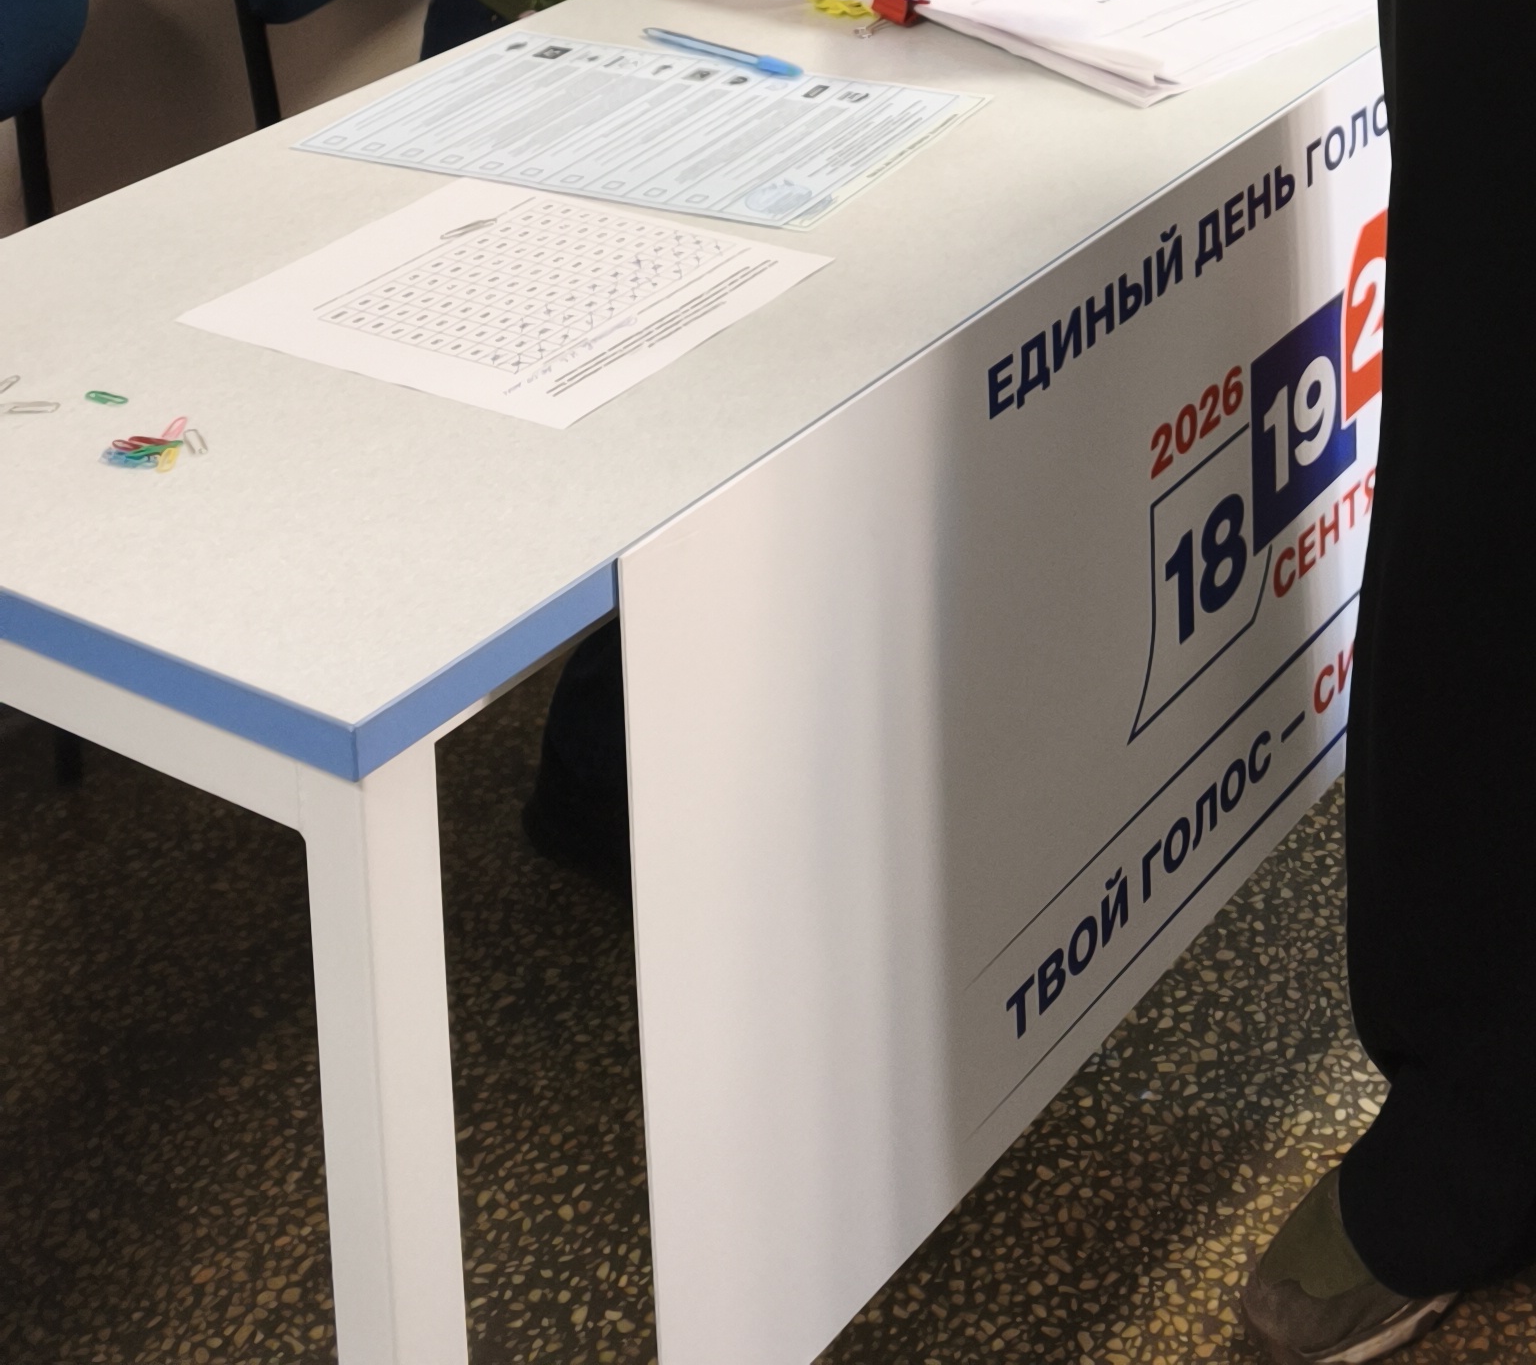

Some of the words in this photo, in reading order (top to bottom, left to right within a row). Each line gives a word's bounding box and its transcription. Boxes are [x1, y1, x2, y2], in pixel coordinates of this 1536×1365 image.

[987, 223, 1184, 421] ЕДИНЫЙ
[1195, 164, 1297, 278] ДЕНЬ
[1306, 93, 1389, 188] ГОЛО
[1351, 256, 1386, 373] 2
[1150, 364, 1244, 481] 2026
[1262, 355, 1337, 495] 19
[1164, 492, 1248, 646] 18
[1273, 466, 1376, 599] СЕНТЯ
[1005, 866, 1130, 1041] ТВОЙ
[1142, 729, 1273, 905] ГОЛОС
[1313, 640, 1355, 715] СИ
